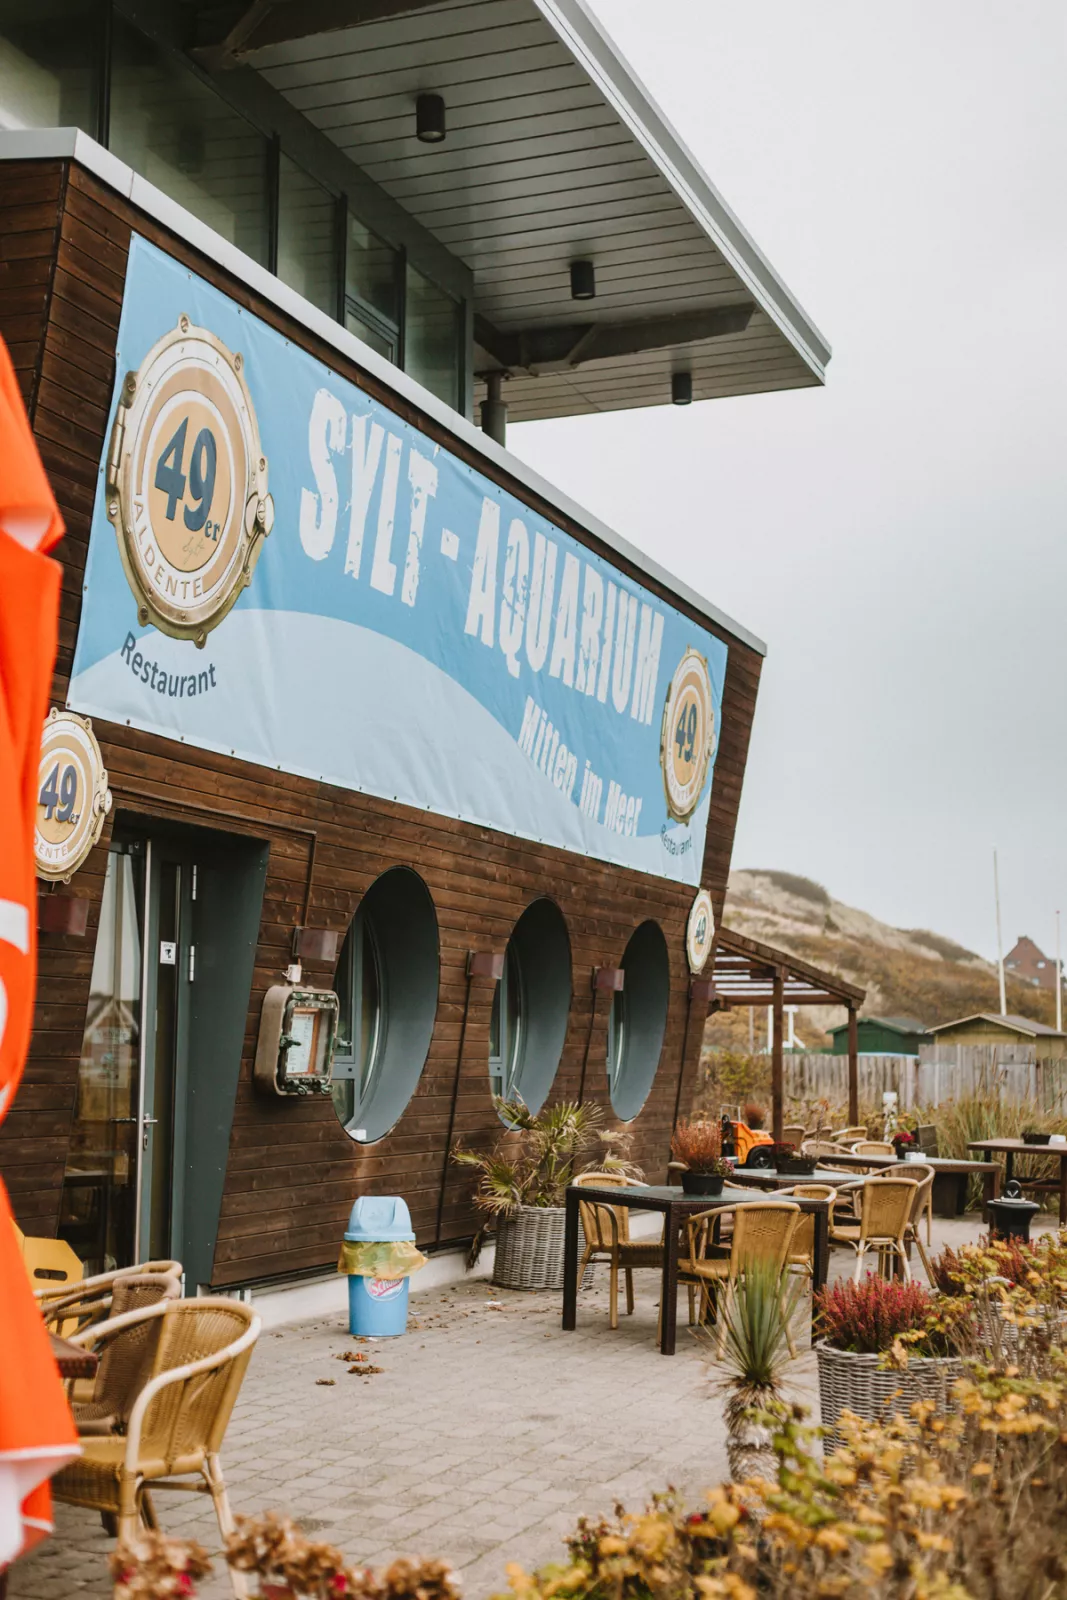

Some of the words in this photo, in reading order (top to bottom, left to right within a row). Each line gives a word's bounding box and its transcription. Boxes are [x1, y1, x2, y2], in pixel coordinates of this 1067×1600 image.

[299, 388, 438, 607] SYLT
[464, 496, 665, 726] AQUARIUM
[120, 631, 217, 698] Restaurant
[517, 695, 578, 800] Mitten
[579, 759, 603, 821] im
[604, 779, 643, 838] Meer
